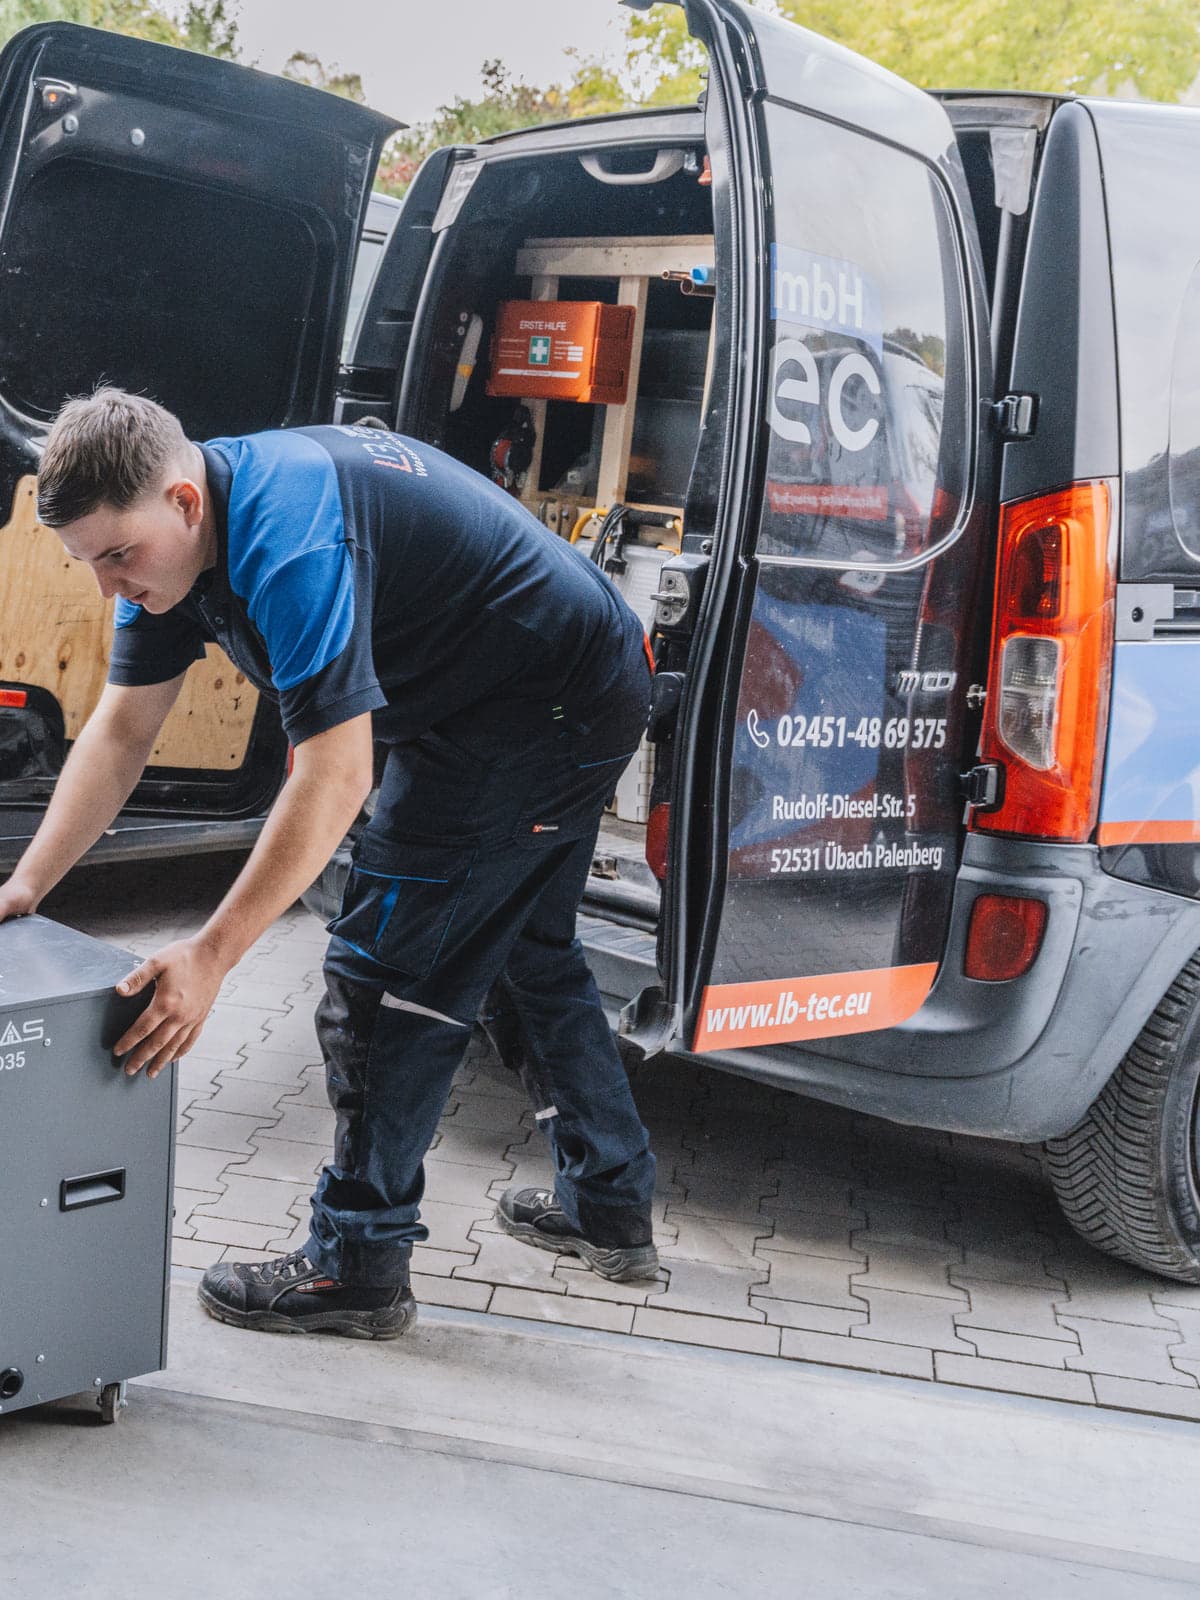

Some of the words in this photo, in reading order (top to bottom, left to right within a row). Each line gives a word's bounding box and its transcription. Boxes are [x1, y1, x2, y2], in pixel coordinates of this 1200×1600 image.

[519, 320, 544, 331] ERSTE
[545, 321, 567, 331] HILFE
[777, 715, 881, 748] 02451-48
[884, 718, 910, 749] 69
[912, 718, 947, 749] 375
[773, 794, 905, 819] Rudolf-Diesel-Str.
[907, 795, 916, 817] 5
[770, 848, 820, 873] 52531
[825, 841, 872, 870] Übach
[875, 842, 943, 871] Palenberg
[706, 991, 872, 1033] www.lb-tec.eu
